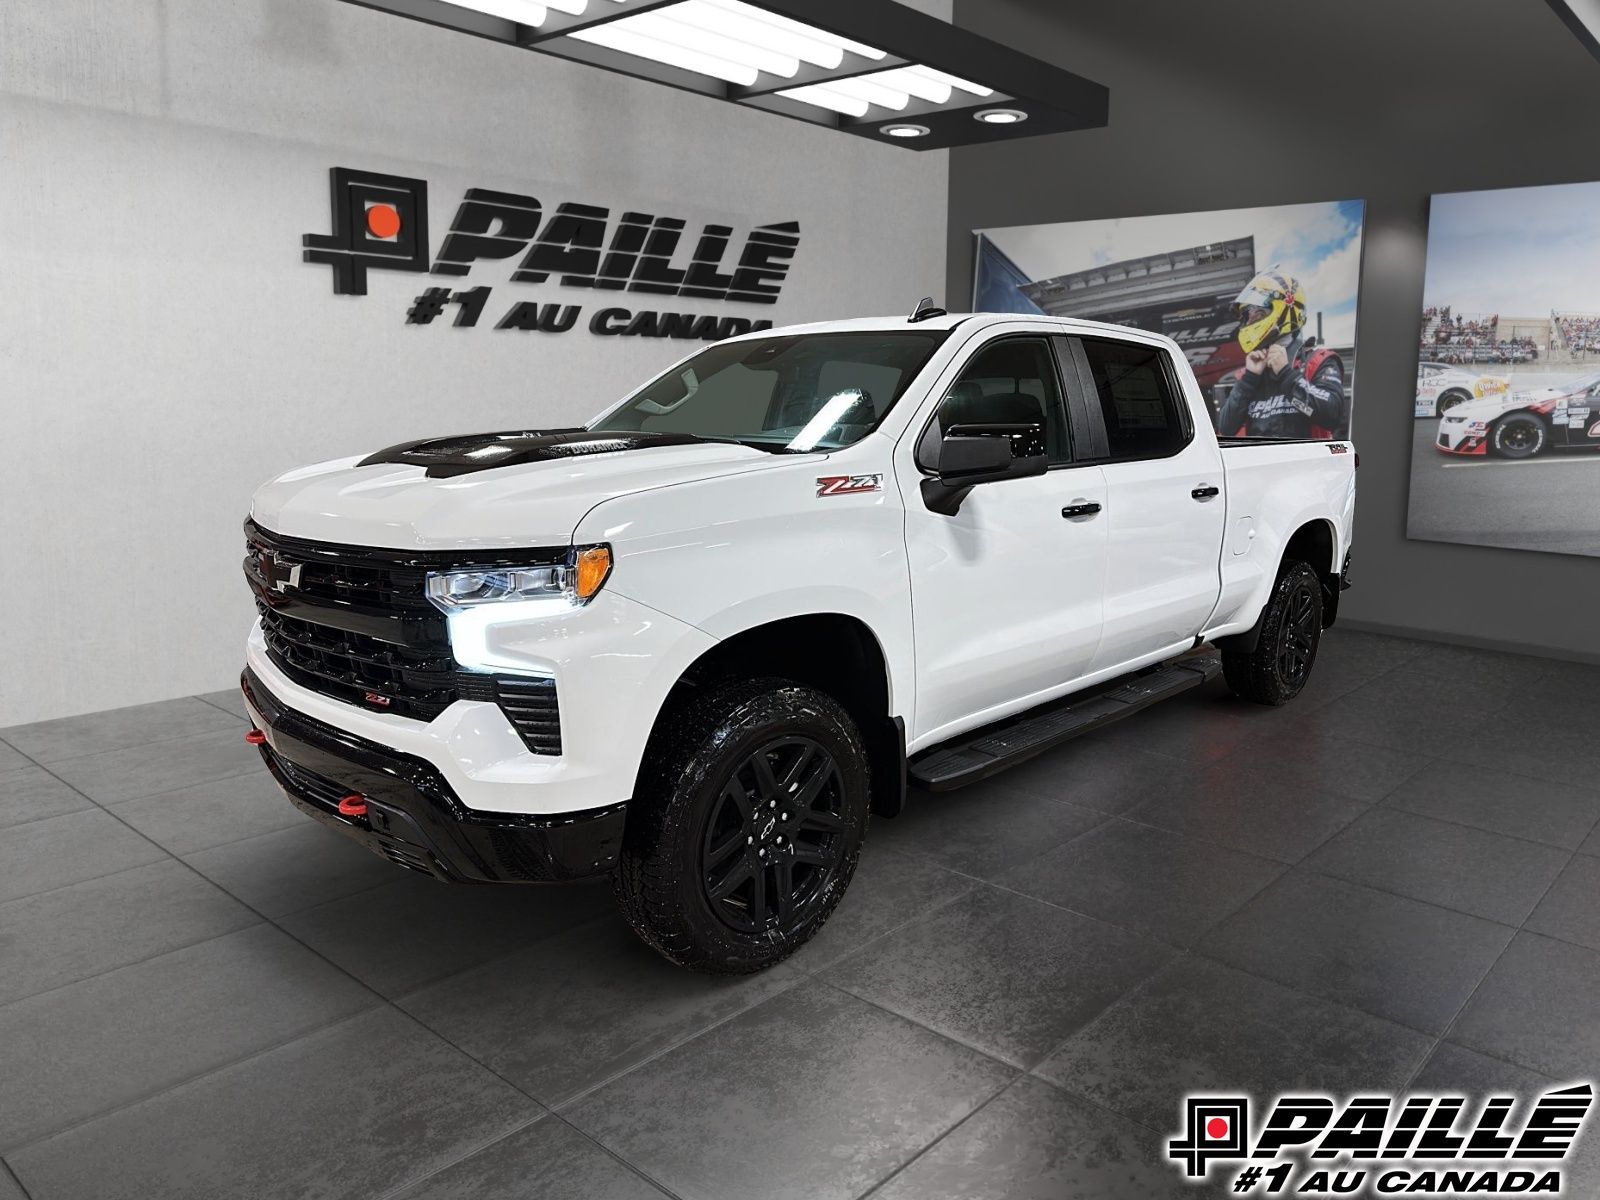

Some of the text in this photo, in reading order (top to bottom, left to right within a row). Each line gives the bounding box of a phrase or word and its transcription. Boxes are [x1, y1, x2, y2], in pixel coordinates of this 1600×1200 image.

[429, 187, 801, 305] PAILLÉ
[405, 286, 493, 328] #1
[493, 301, 583, 333] AU
[571, 441, 628, 455] DURAMAX
[816, 473, 883, 498] Z71
